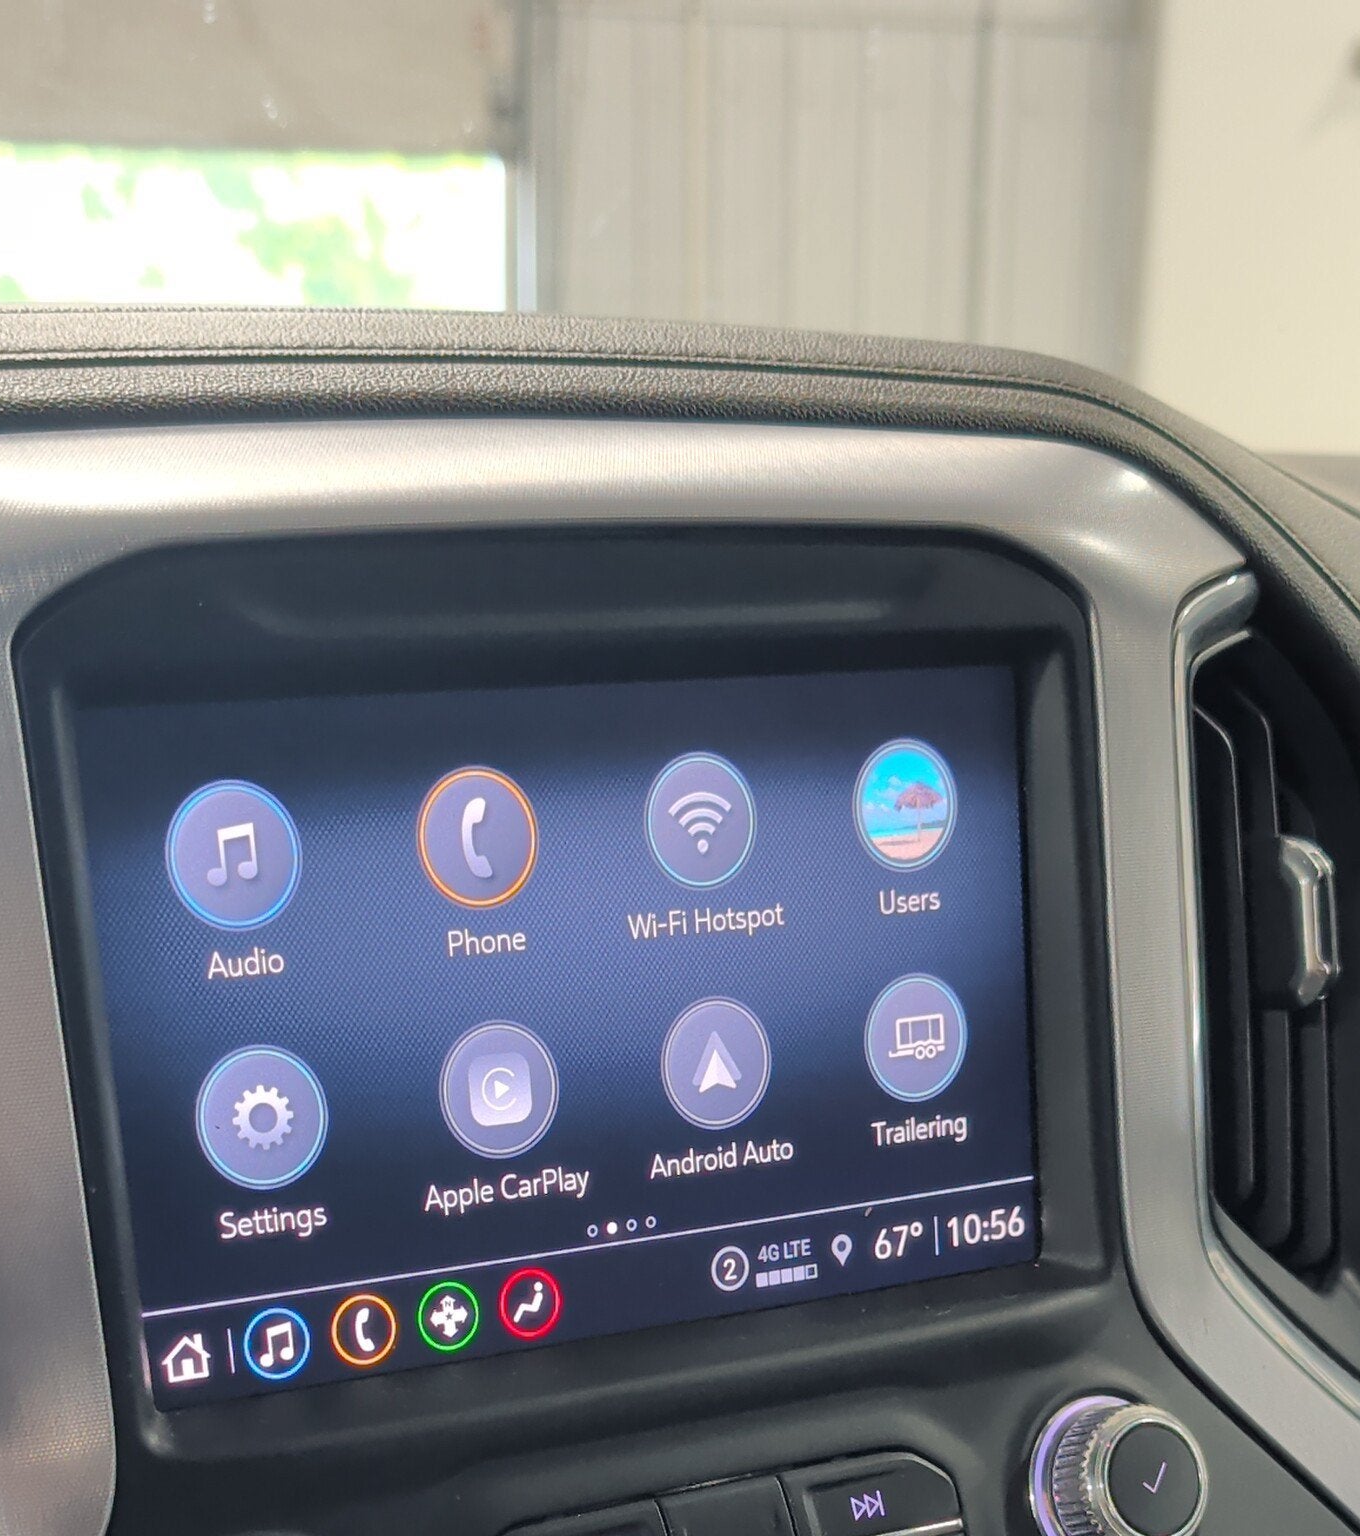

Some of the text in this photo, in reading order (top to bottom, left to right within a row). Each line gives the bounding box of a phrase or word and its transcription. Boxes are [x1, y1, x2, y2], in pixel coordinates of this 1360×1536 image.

[880, 890, 940, 915] Users
[628, 904, 784, 939] Wi-Fi Hotspot
[448, 929, 526, 956] Phone
[208, 947, 284, 979] Audio
[871, 1115, 967, 1146] Trailering
[651, 1140, 793, 1179] Android Auto
[425, 1167, 589, 1215] Apple CarPlay
[220, 1206, 327, 1239] Settings
[947, 1206, 1025, 1246] 10:56
[758, 1239, 811, 1262] 4G LTE
[723, 1259, 737, 1281] 2
